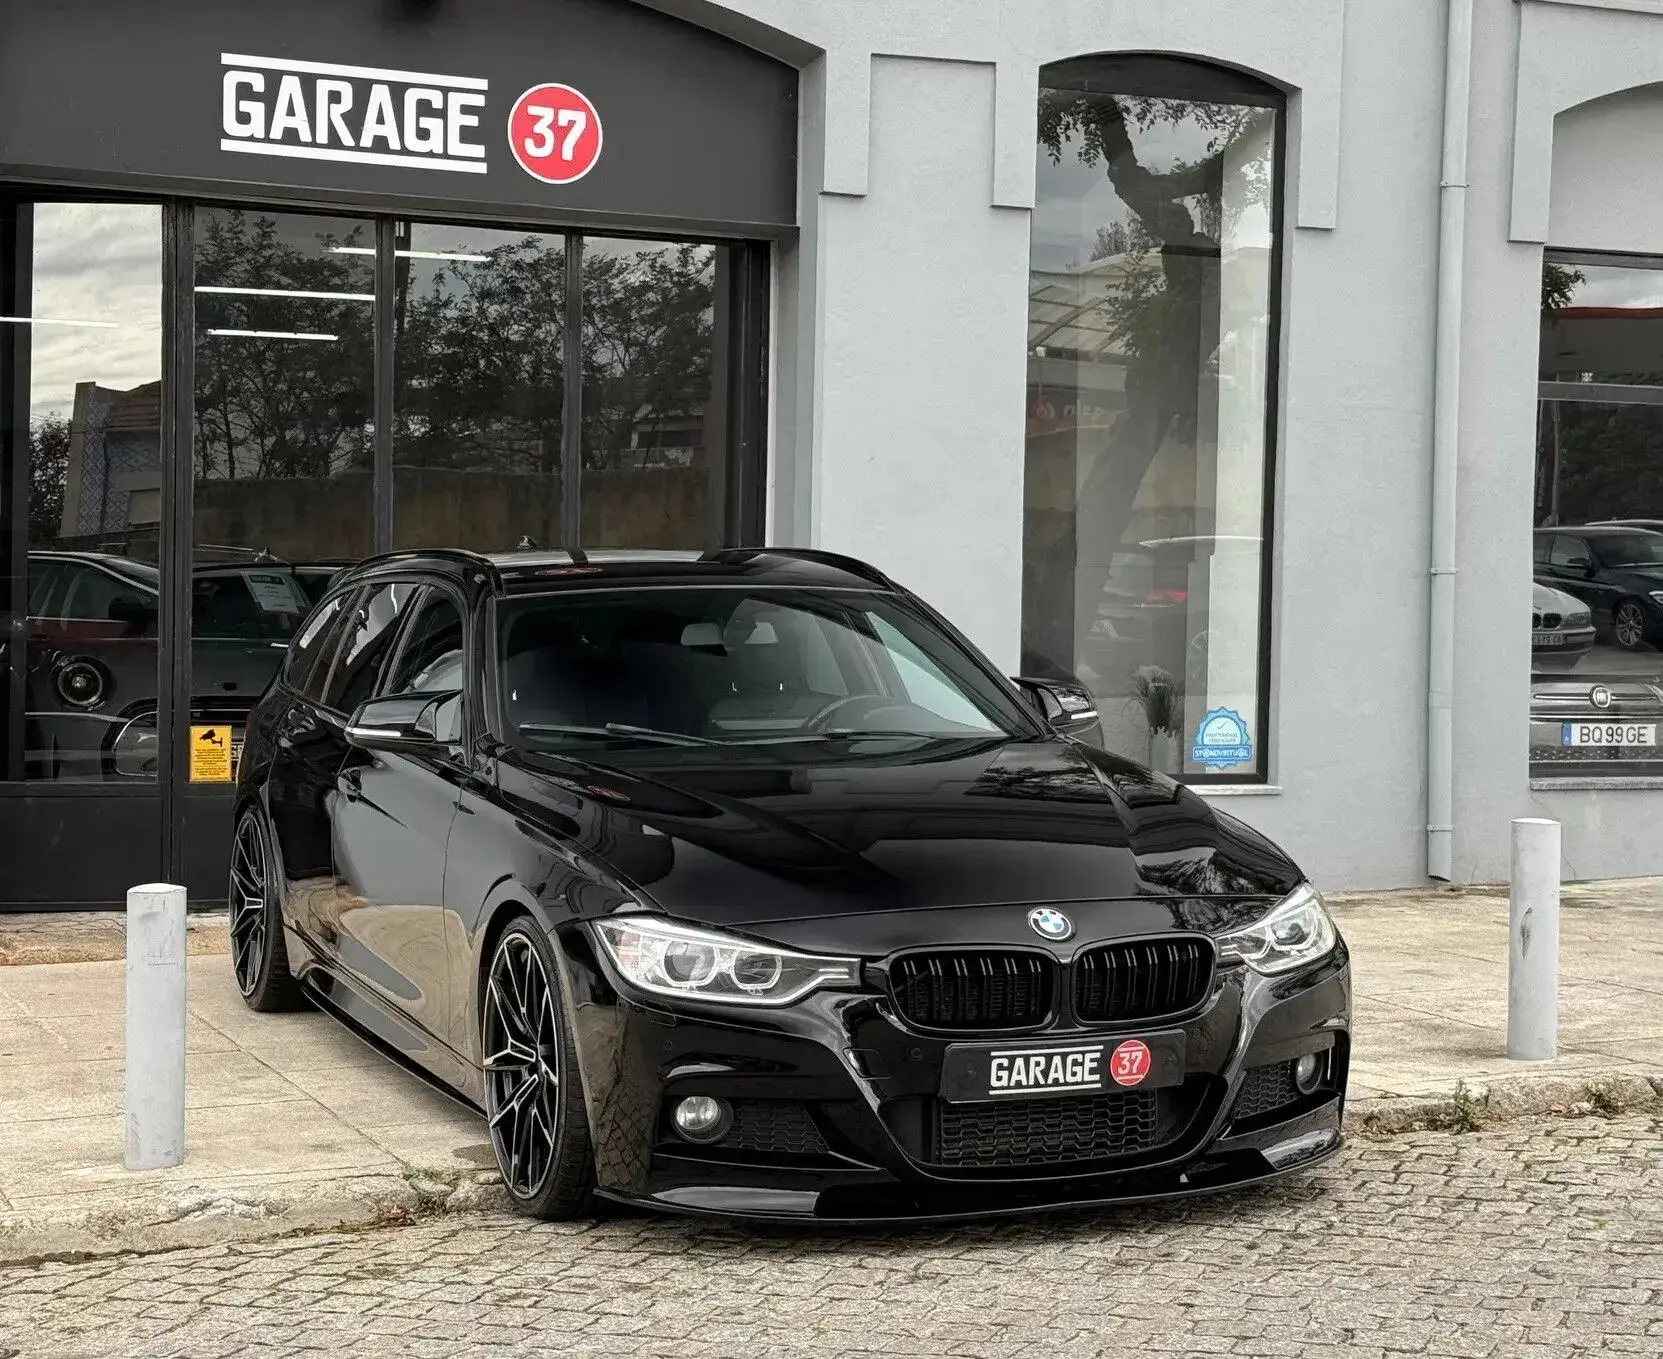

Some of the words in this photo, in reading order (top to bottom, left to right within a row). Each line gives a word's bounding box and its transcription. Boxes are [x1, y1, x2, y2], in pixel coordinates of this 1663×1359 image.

[222, 70, 486, 158] GARAGE
[524, 104, 587, 161] 37
[1579, 726, 1603, 743] BQ
[1605, 726, 1624, 743] 99
[1626, 726, 1648, 743] GE
[990, 1052, 1101, 1087] GARAGE
[1117, 1051, 1143, 1075] 37
